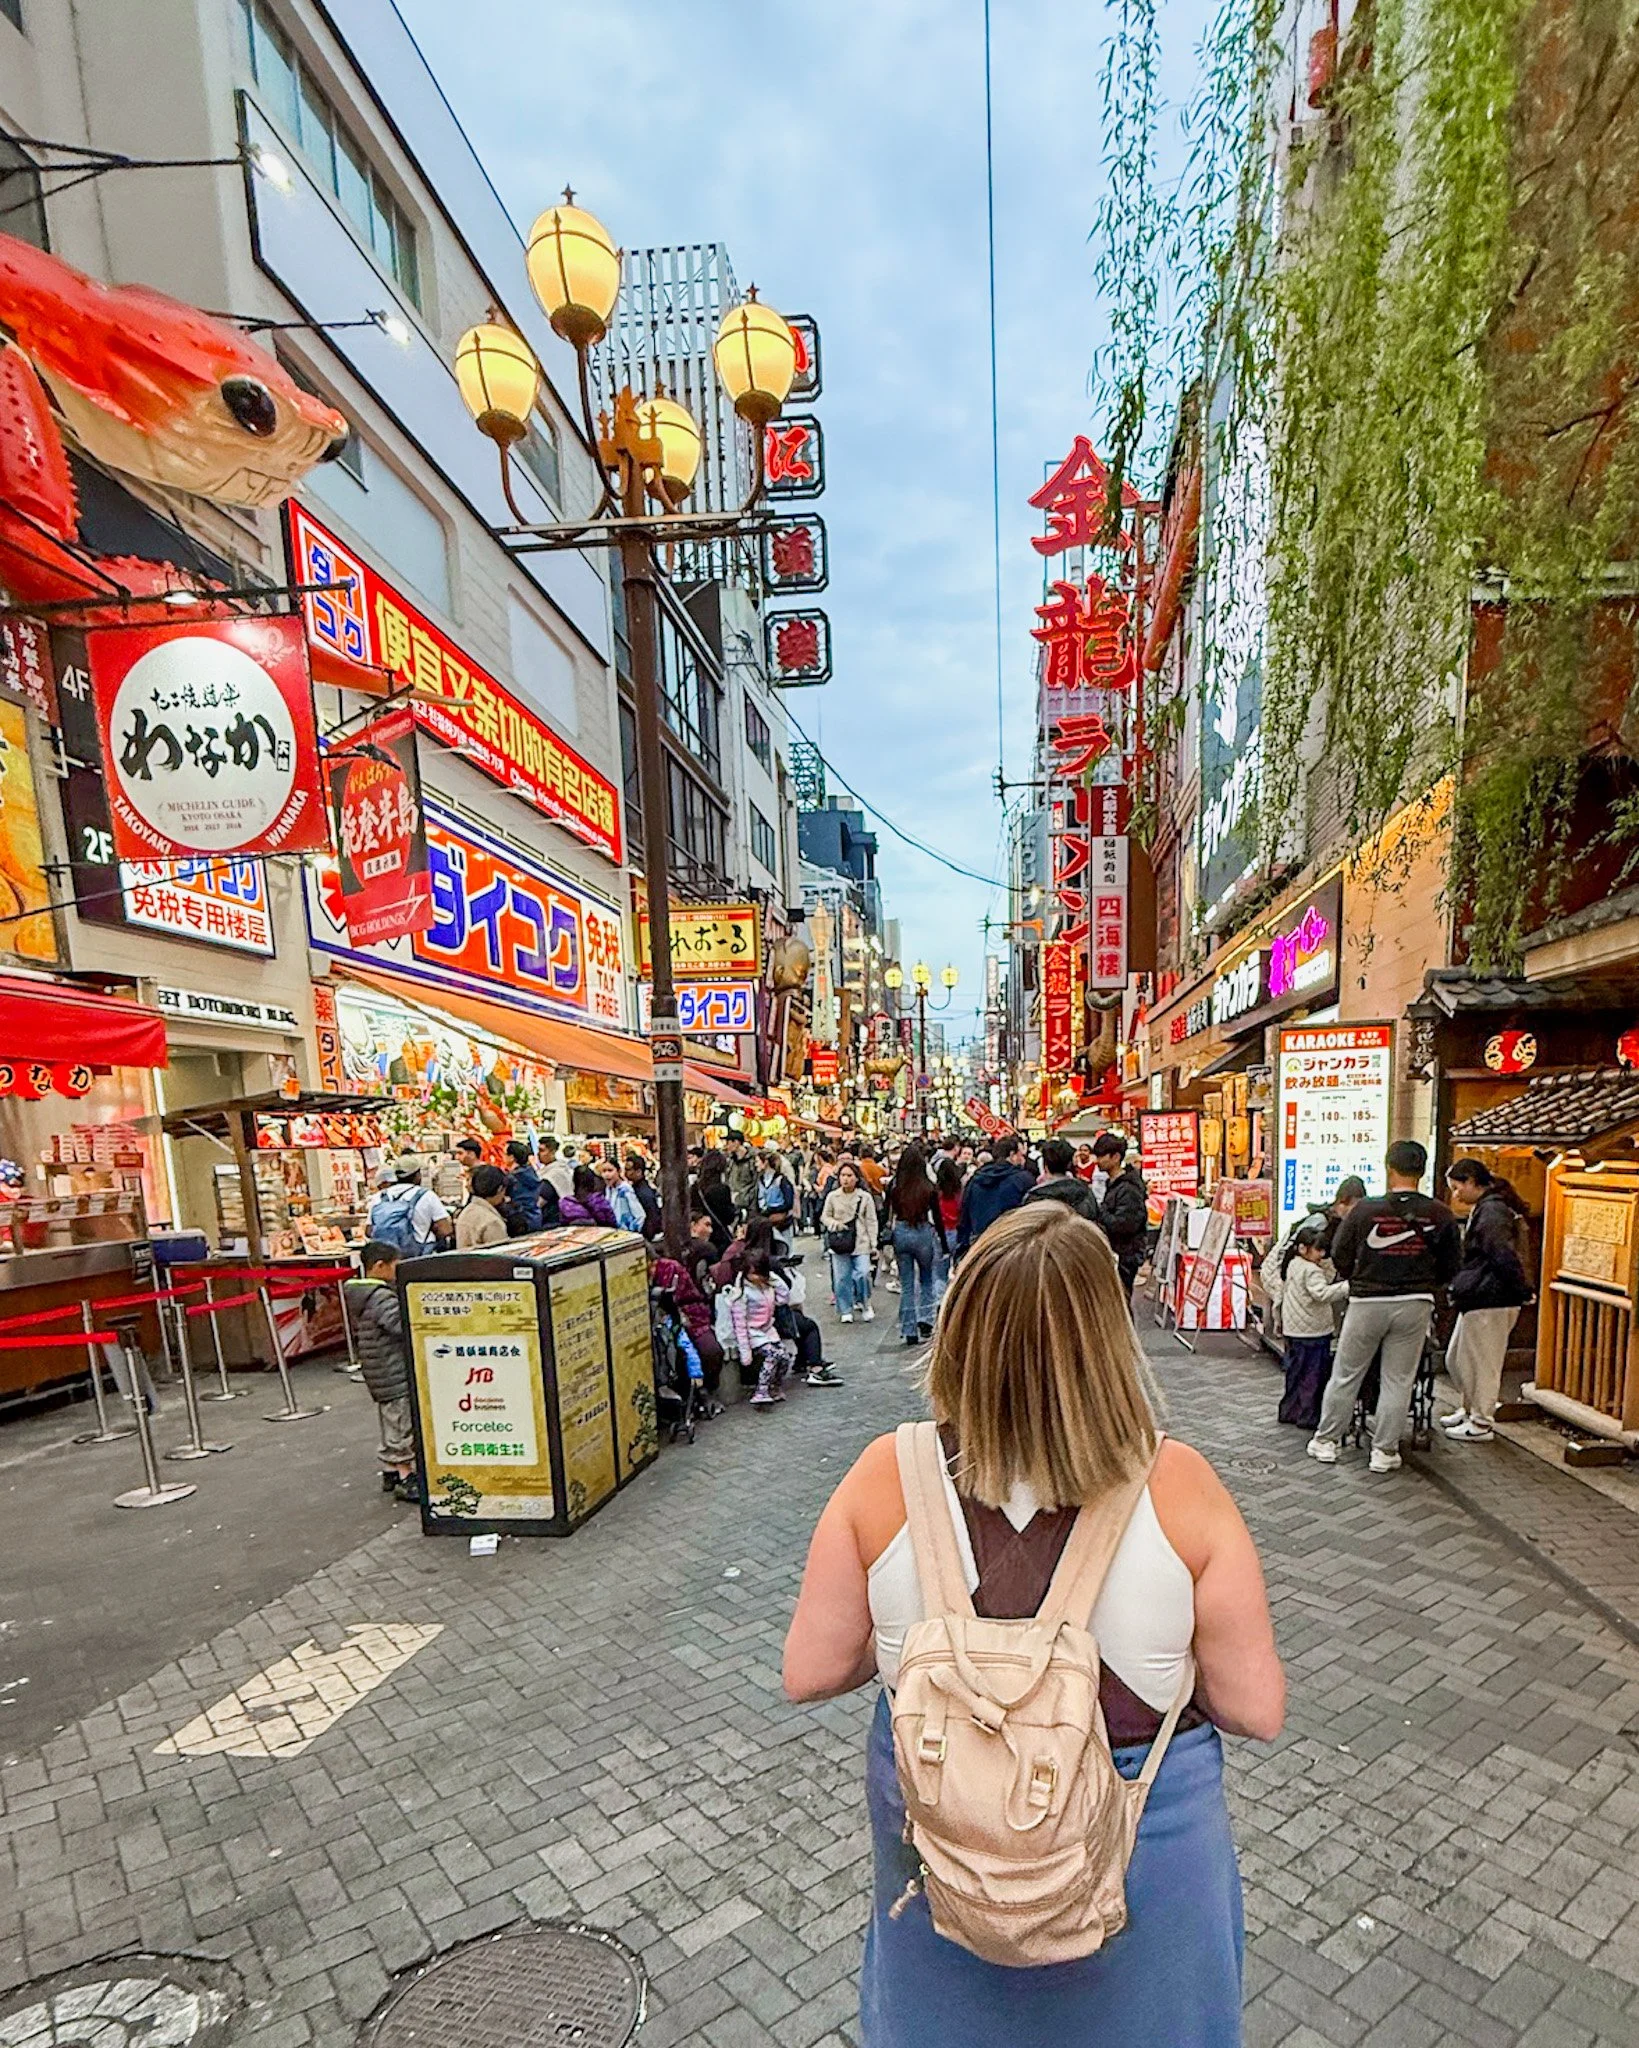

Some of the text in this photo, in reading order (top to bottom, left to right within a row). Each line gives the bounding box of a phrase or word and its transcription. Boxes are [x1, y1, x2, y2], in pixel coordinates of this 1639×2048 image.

[62, 665, 91, 701] 4F
[120, 708, 277, 781] わなか
[168, 798, 256, 813] MICHELIN GUIDE
[181, 812, 243, 823] KYOTO OSAKA
[113, 788, 310, 856] TAKOYAKI WANAKA
[339, 781, 418, 858] 能登半島
[83, 826, 112, 865] 2F
[132, 885, 268, 946] 免税专用楼层
[586, 911, 621, 973] 免税
[597, 969, 616, 992] TAX
[596, 993, 620, 1018] FREE
[681, 991, 748, 1026] ダイコク
[1047, 945, 1071, 1073] 金龍ラーメン
[1285, 1031, 1356, 1051] KARAOKE
[1303, 1055, 1370, 1072] ジャンカラ
[1284, 1074, 1339, 1090] 飲み放題
[1321, 1111, 1340, 1121] 140
[1320, 1133, 1339, 1144] 175
[465, 1367, 494, 1386] JTB
[452, 1420, 514, 1433] Forcetec
